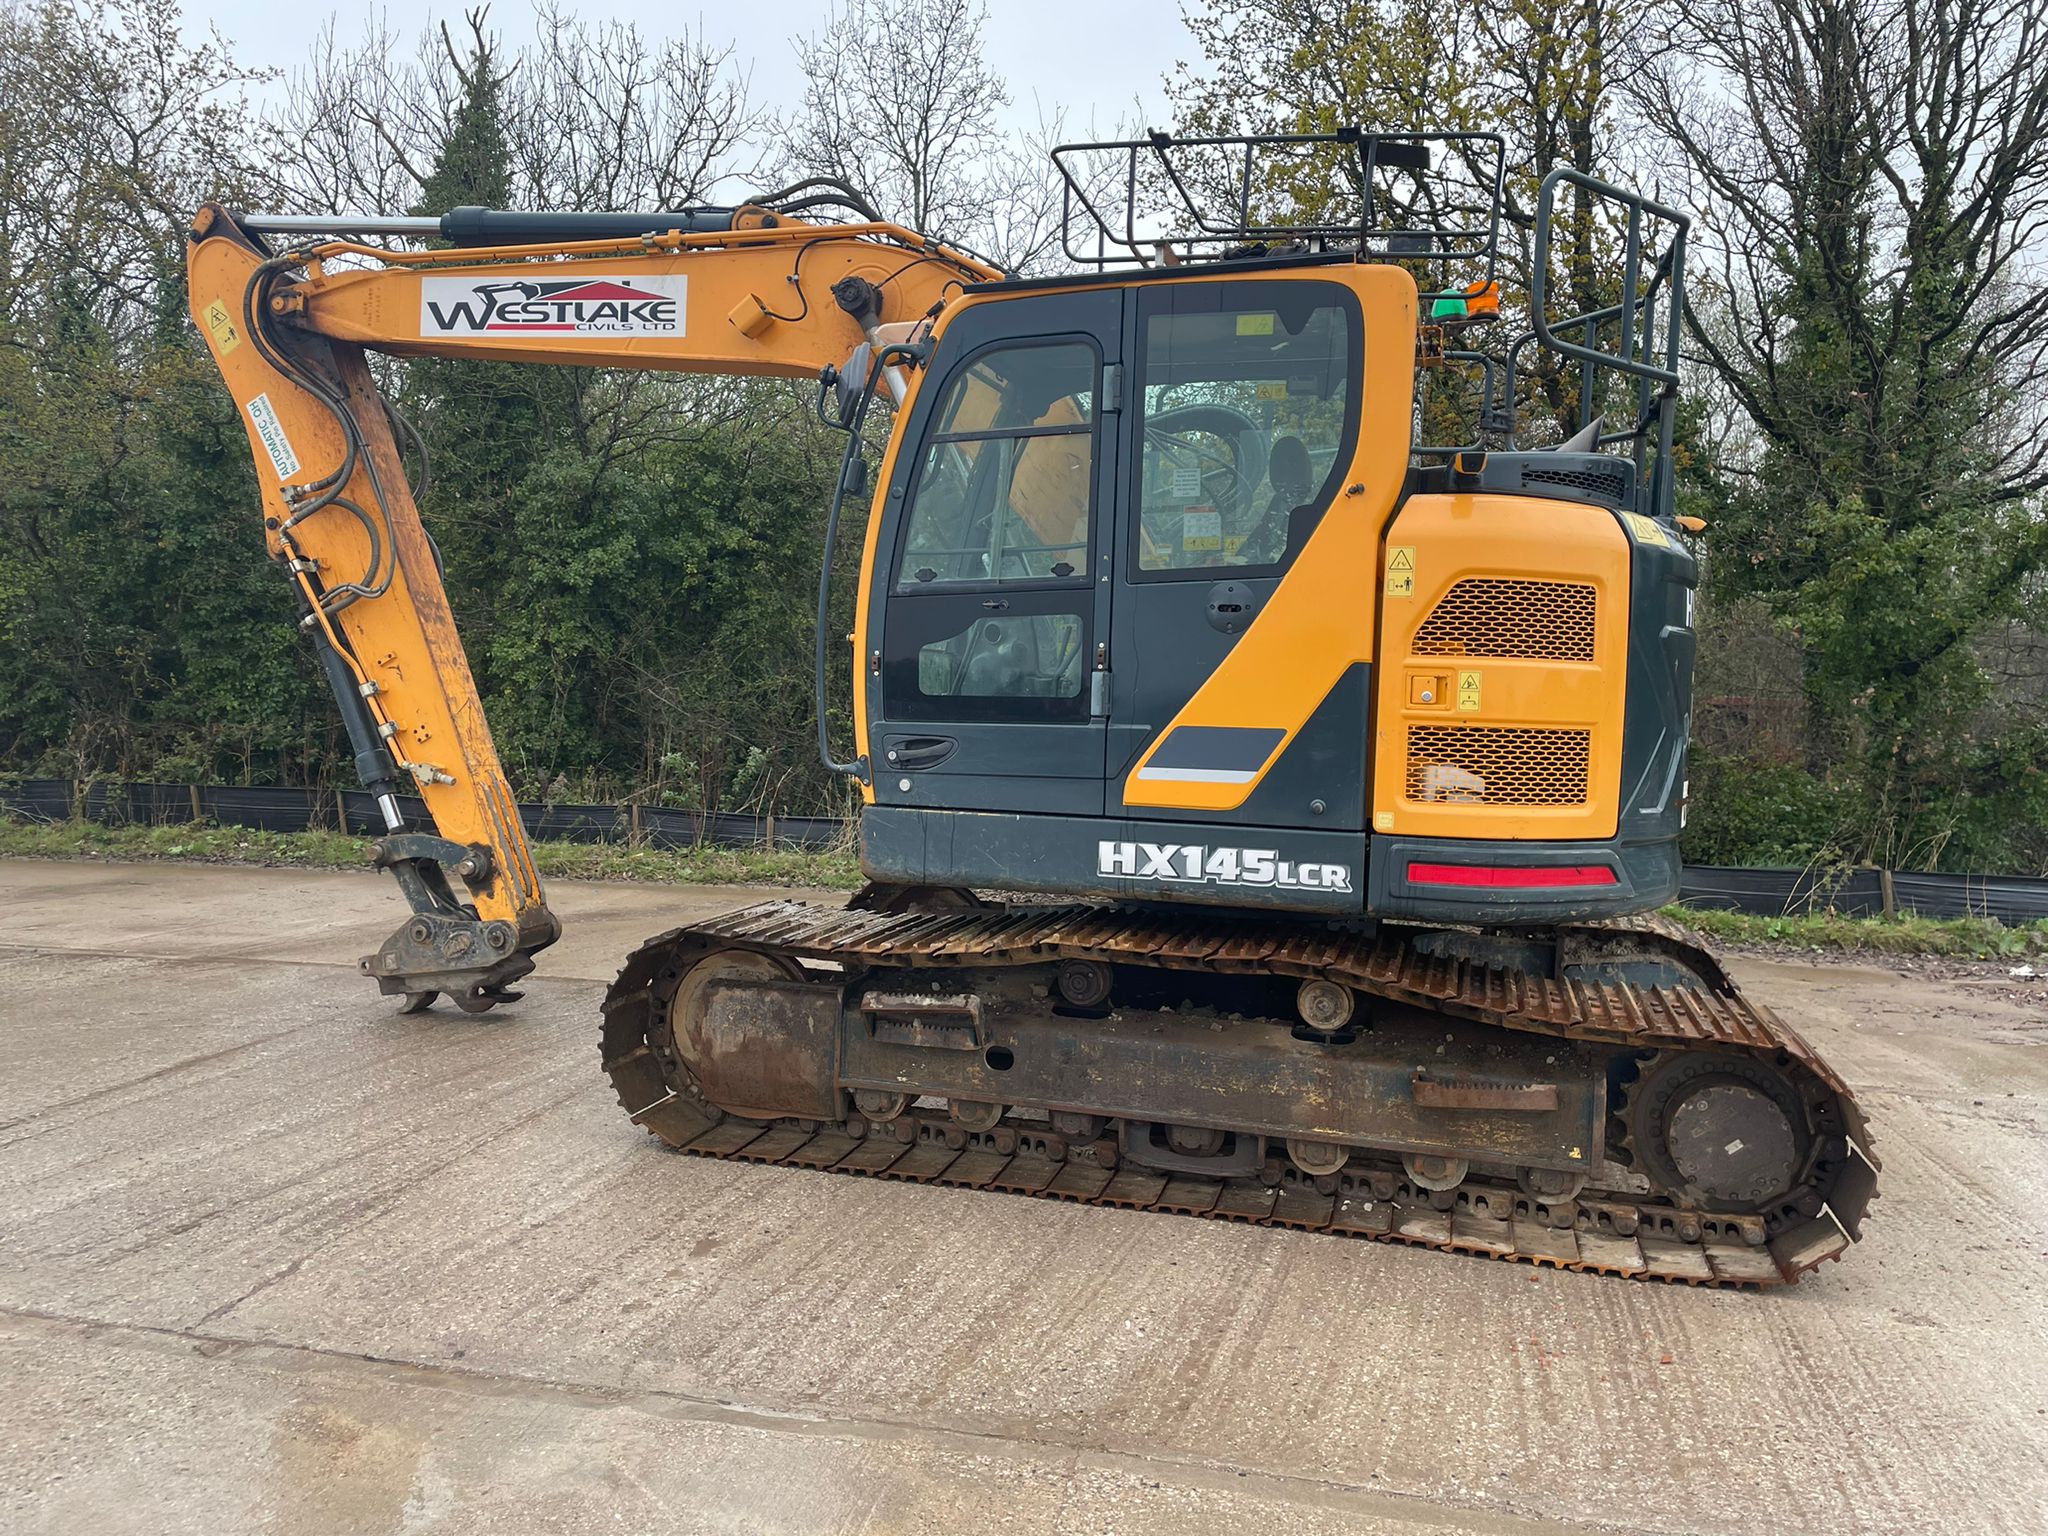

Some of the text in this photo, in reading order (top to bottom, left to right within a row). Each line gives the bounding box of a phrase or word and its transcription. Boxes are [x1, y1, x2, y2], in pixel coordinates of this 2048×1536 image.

[427, 301, 676, 330] WESTLAKE
[575, 323, 676, 331] CIVILS LTD
[258, 396, 274, 426] Required
[249, 400, 290, 476] AUTOMATIC QH
[273, 426, 281, 438] Pin
[279, 438, 292, 460] Safety
[1098, 841, 1352, 892] HX145LCR
